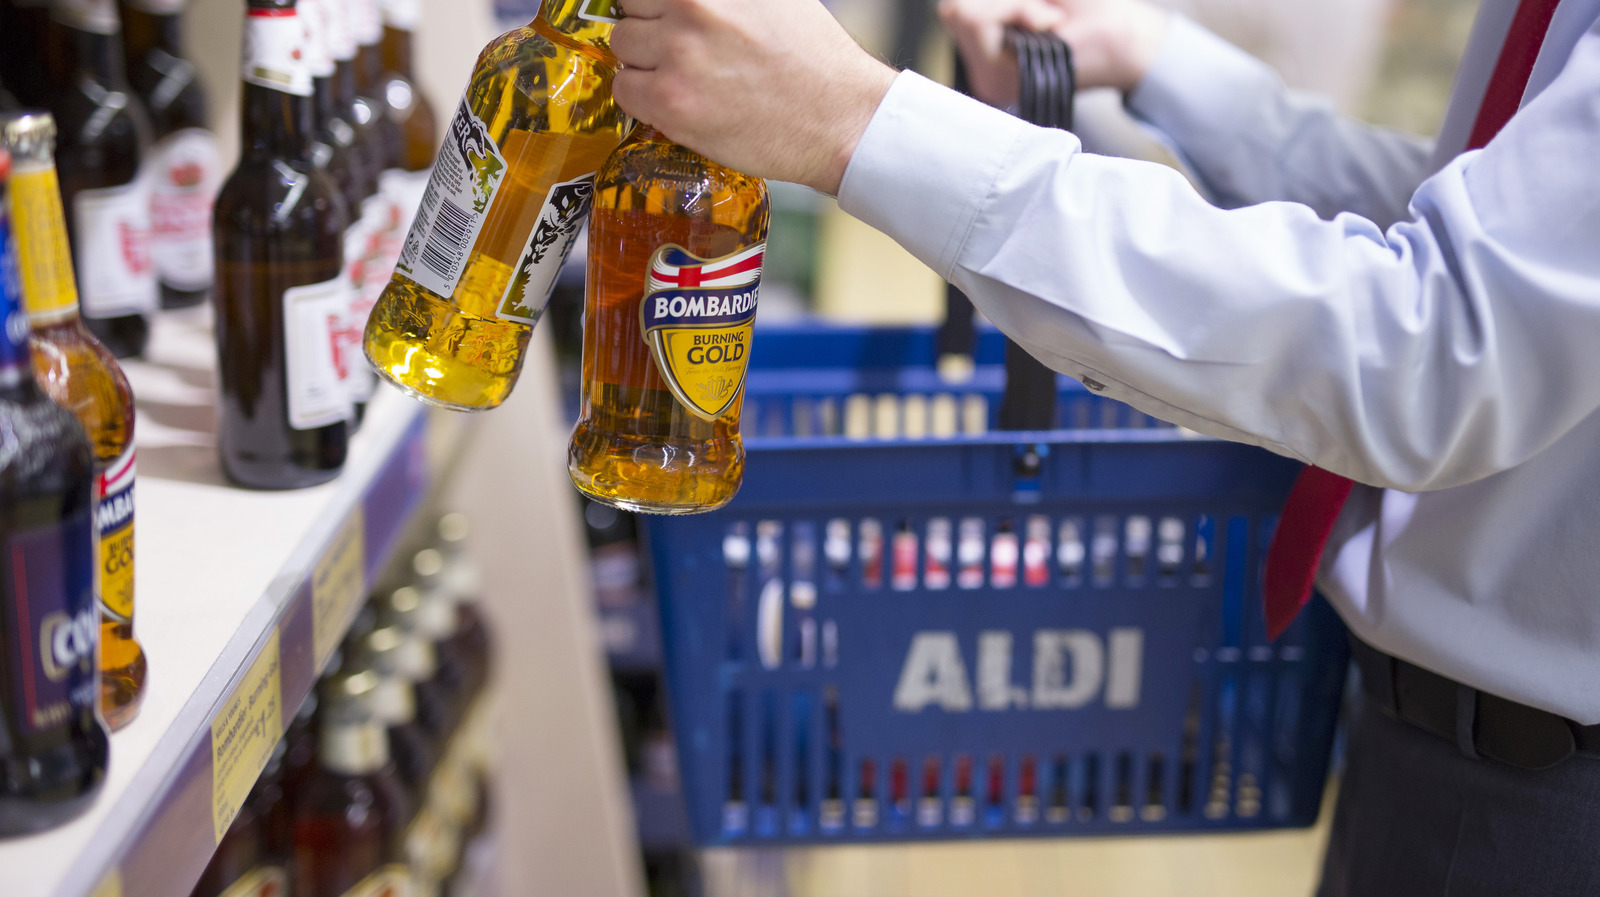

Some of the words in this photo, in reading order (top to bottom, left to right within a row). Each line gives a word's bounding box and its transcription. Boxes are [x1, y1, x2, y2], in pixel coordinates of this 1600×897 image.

[447, 252, 464, 281] 010548
[460, 219, 477, 249] 002911
[654, 286, 759, 319] BOMBARDIE
[687, 343, 745, 365] GOLD
[693, 331, 744, 346] BURNING
[893, 627, 1143, 712] ALDI
